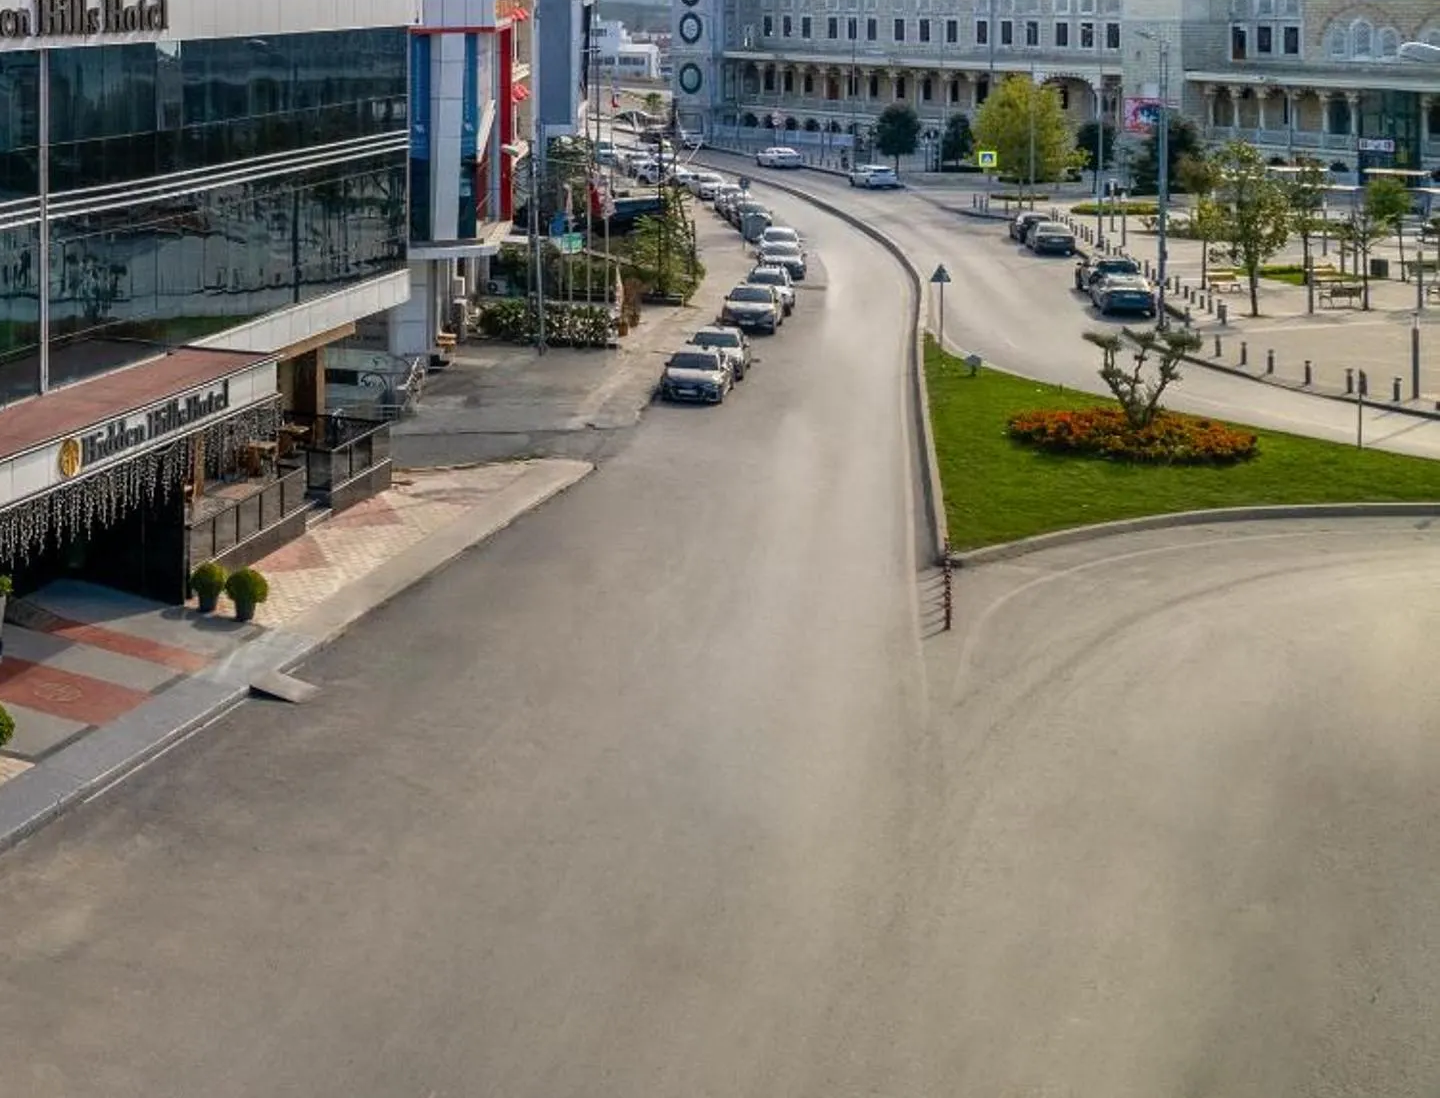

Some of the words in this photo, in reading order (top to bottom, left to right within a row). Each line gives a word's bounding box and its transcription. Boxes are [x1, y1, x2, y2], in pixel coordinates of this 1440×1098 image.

[81, 421, 146, 467] Hidden
[146, 398, 187, 441] Hills
[186, 378, 229, 421] Hotel
